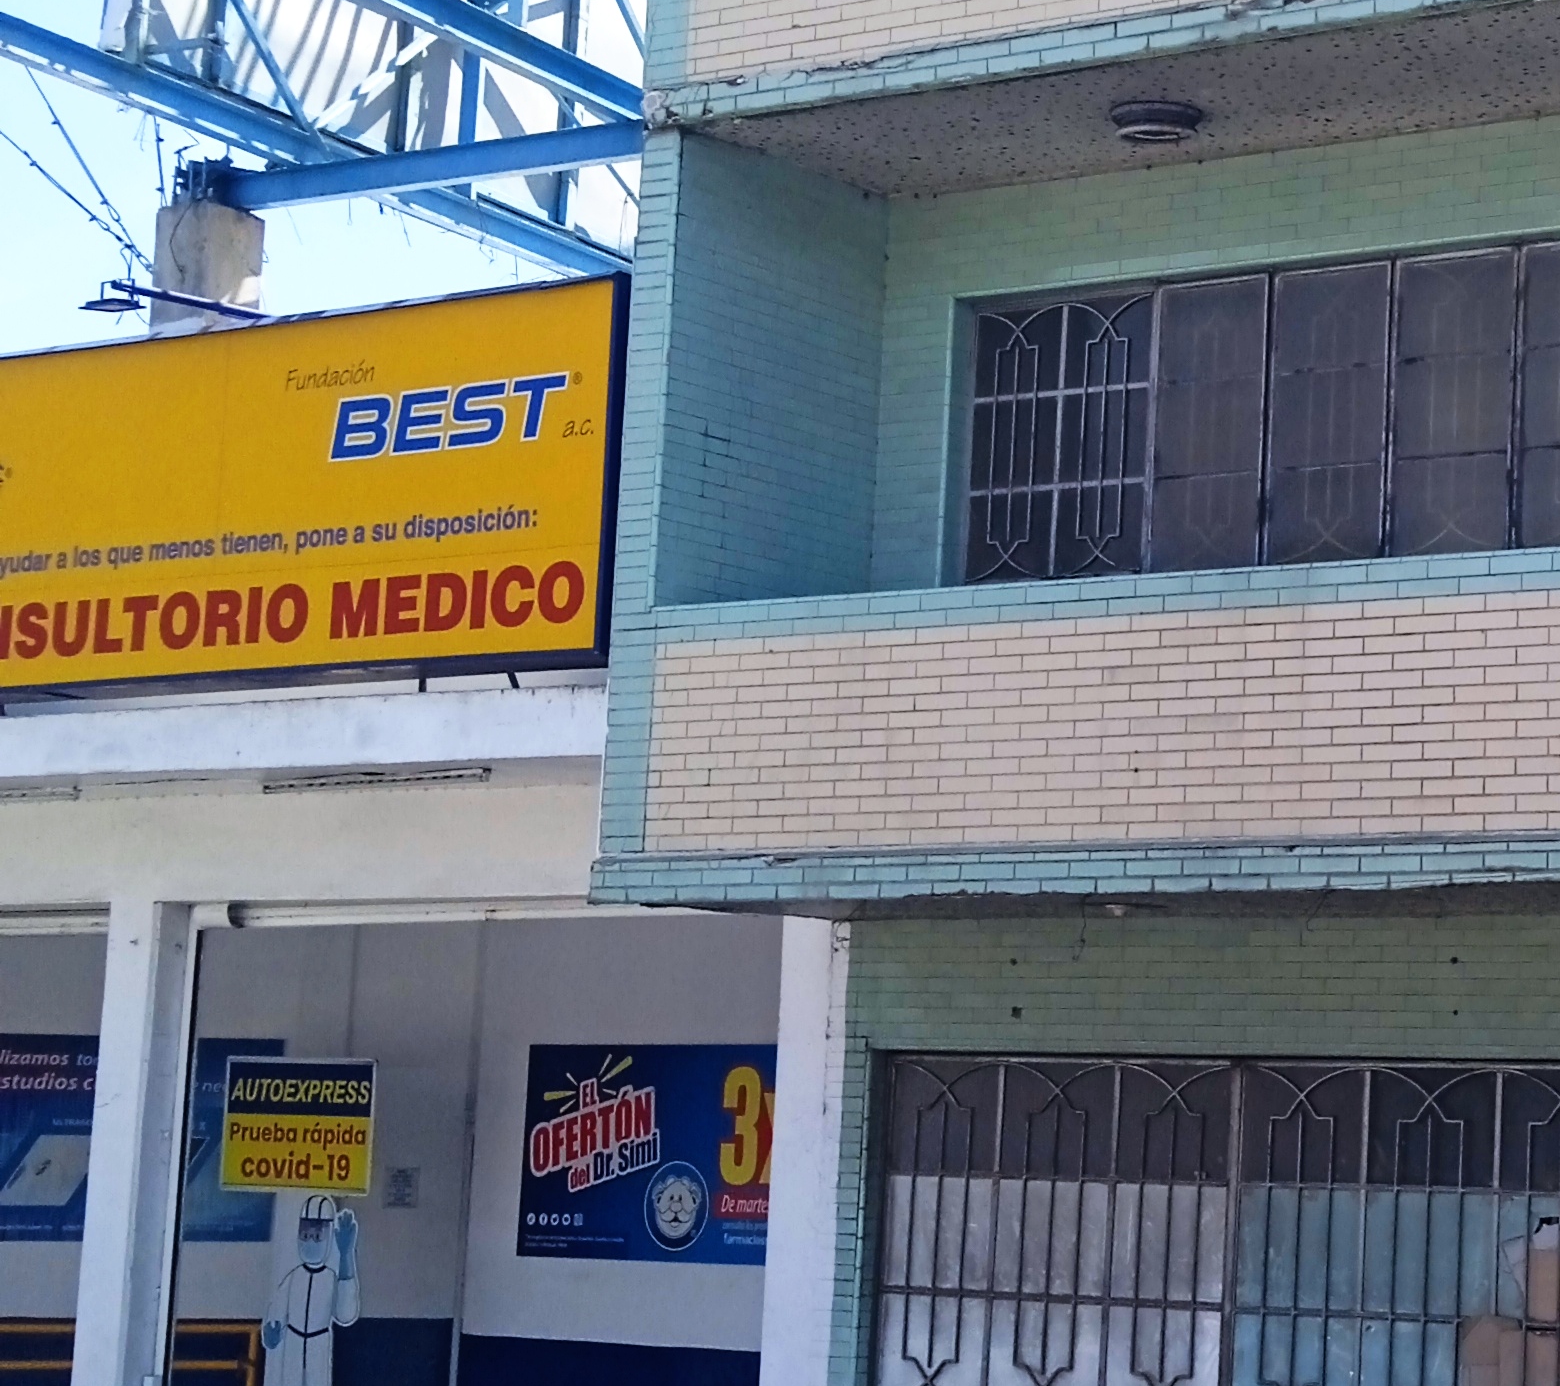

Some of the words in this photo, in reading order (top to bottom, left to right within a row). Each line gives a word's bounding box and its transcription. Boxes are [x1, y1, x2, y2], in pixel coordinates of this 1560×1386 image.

[285, 360, 375, 392] Fundación
[327, 371, 571, 463] BEST
[562, 418, 595, 438] a.c.
[57, 551, 68, 570] a
[74, 545, 102, 568] los
[107, 544, 144, 570] que
[149, 537, 215, 562] menos
[221, 531, 288, 555] tienen,
[295, 528, 348, 555] pone
[352, 525, 365, 544] a
[372, 522, 397, 543] su
[404, 504, 538, 543] disposición:
[329, 560, 585, 640] MEDICO
[0, 1049, 70, 1066] lizamos
[202, 1081, 226, 1093] ne
[231, 1078, 370, 1104] AUTOEXPRESS
[581, 1080, 598, 1109] EL
[230, 1122, 298, 1143] Prueba
[302, 1123, 366, 1151] rápida
[532, 1089, 652, 1173] OFERTÓN
[241, 1151, 351, 1182] covid-19
[569, 1163, 591, 1190] del
[593, 1151, 616, 1182] Dr.
[618, 1132, 658, 1173] Simi
[720, 1194, 736, 1213] De
[736, 1197, 769, 1213] marte
